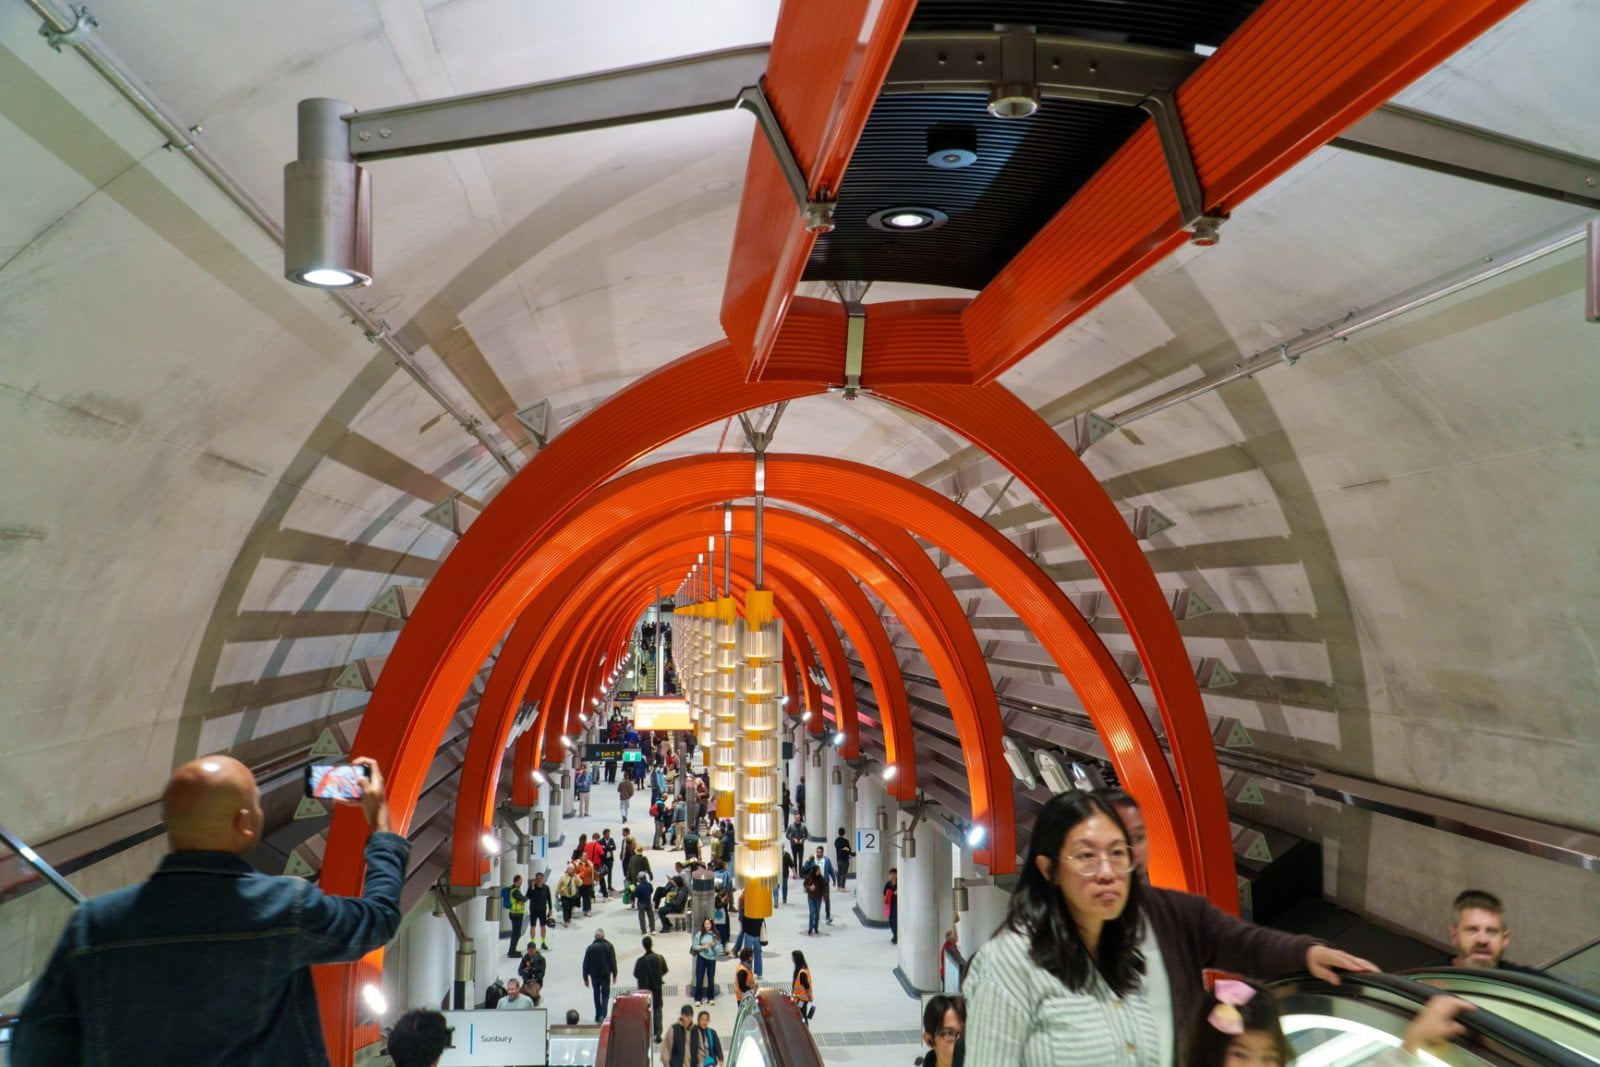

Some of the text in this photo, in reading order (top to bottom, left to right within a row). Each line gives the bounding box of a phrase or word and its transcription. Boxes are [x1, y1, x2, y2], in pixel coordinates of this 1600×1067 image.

[529, 840, 536, 855] 1
[865, 833, 875, 848] 2
[481, 1035, 512, 1043] Sunbury
